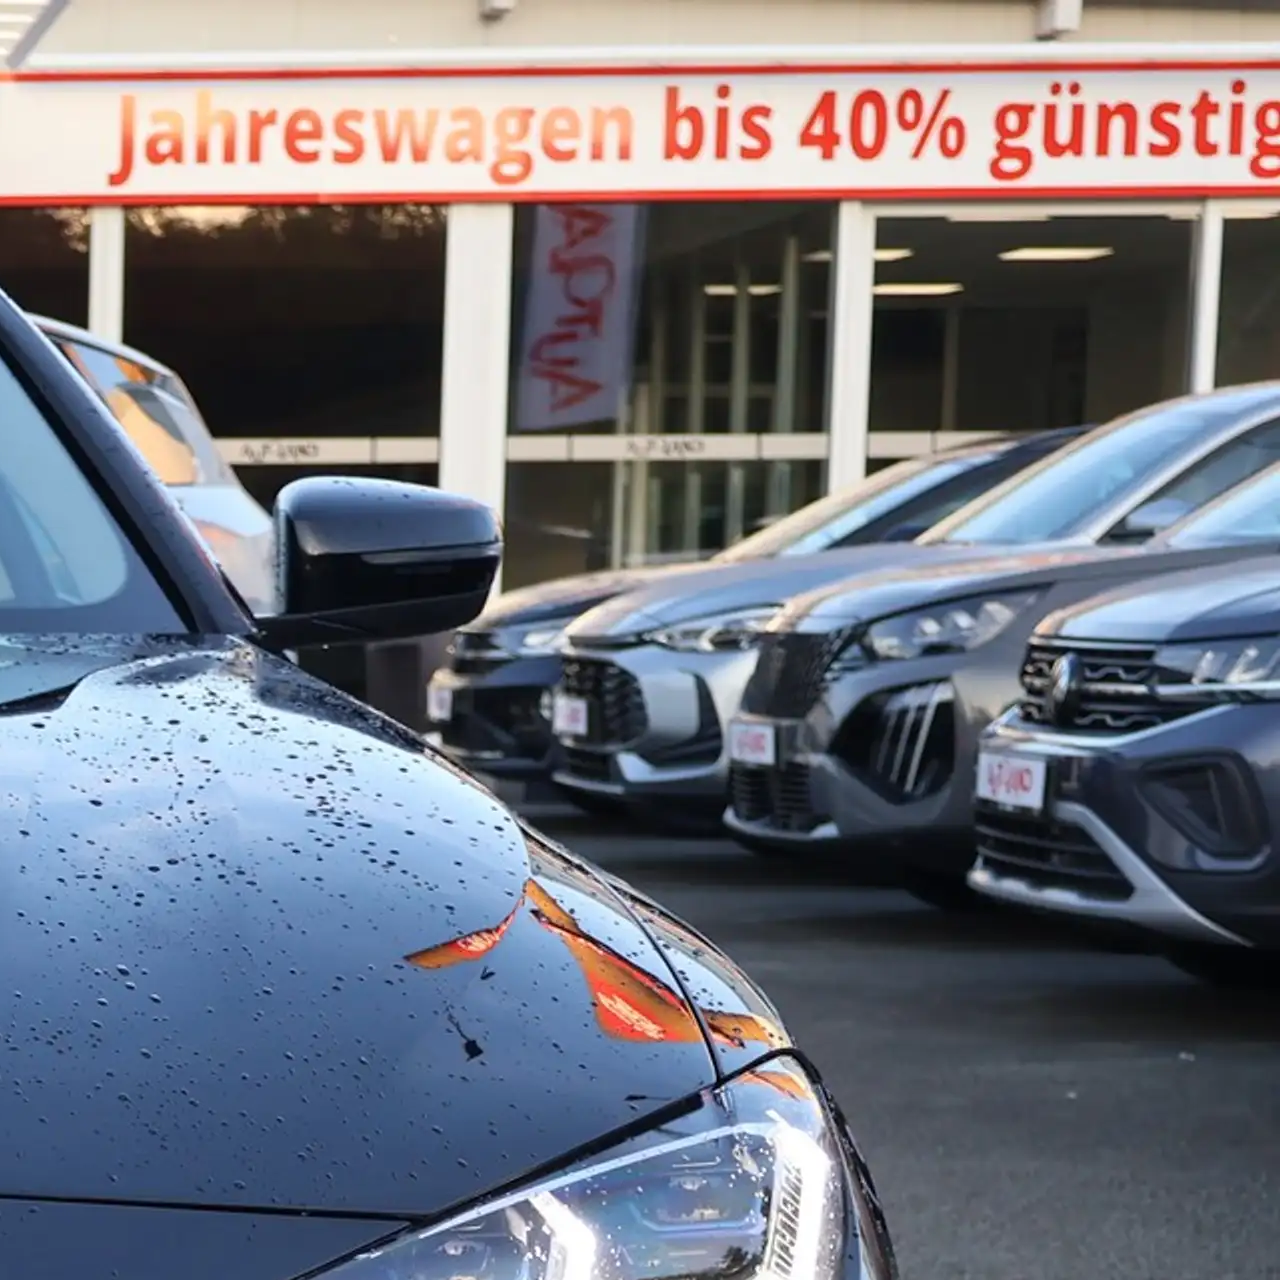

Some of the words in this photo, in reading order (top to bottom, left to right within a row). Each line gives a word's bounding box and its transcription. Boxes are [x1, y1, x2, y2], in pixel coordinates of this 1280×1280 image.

[106, 88, 634, 187] Jahreswagen
[662, 84, 774, 163] bis
[798, 86, 968, 163] 40%
[989, 79, 1280, 181] günstig
